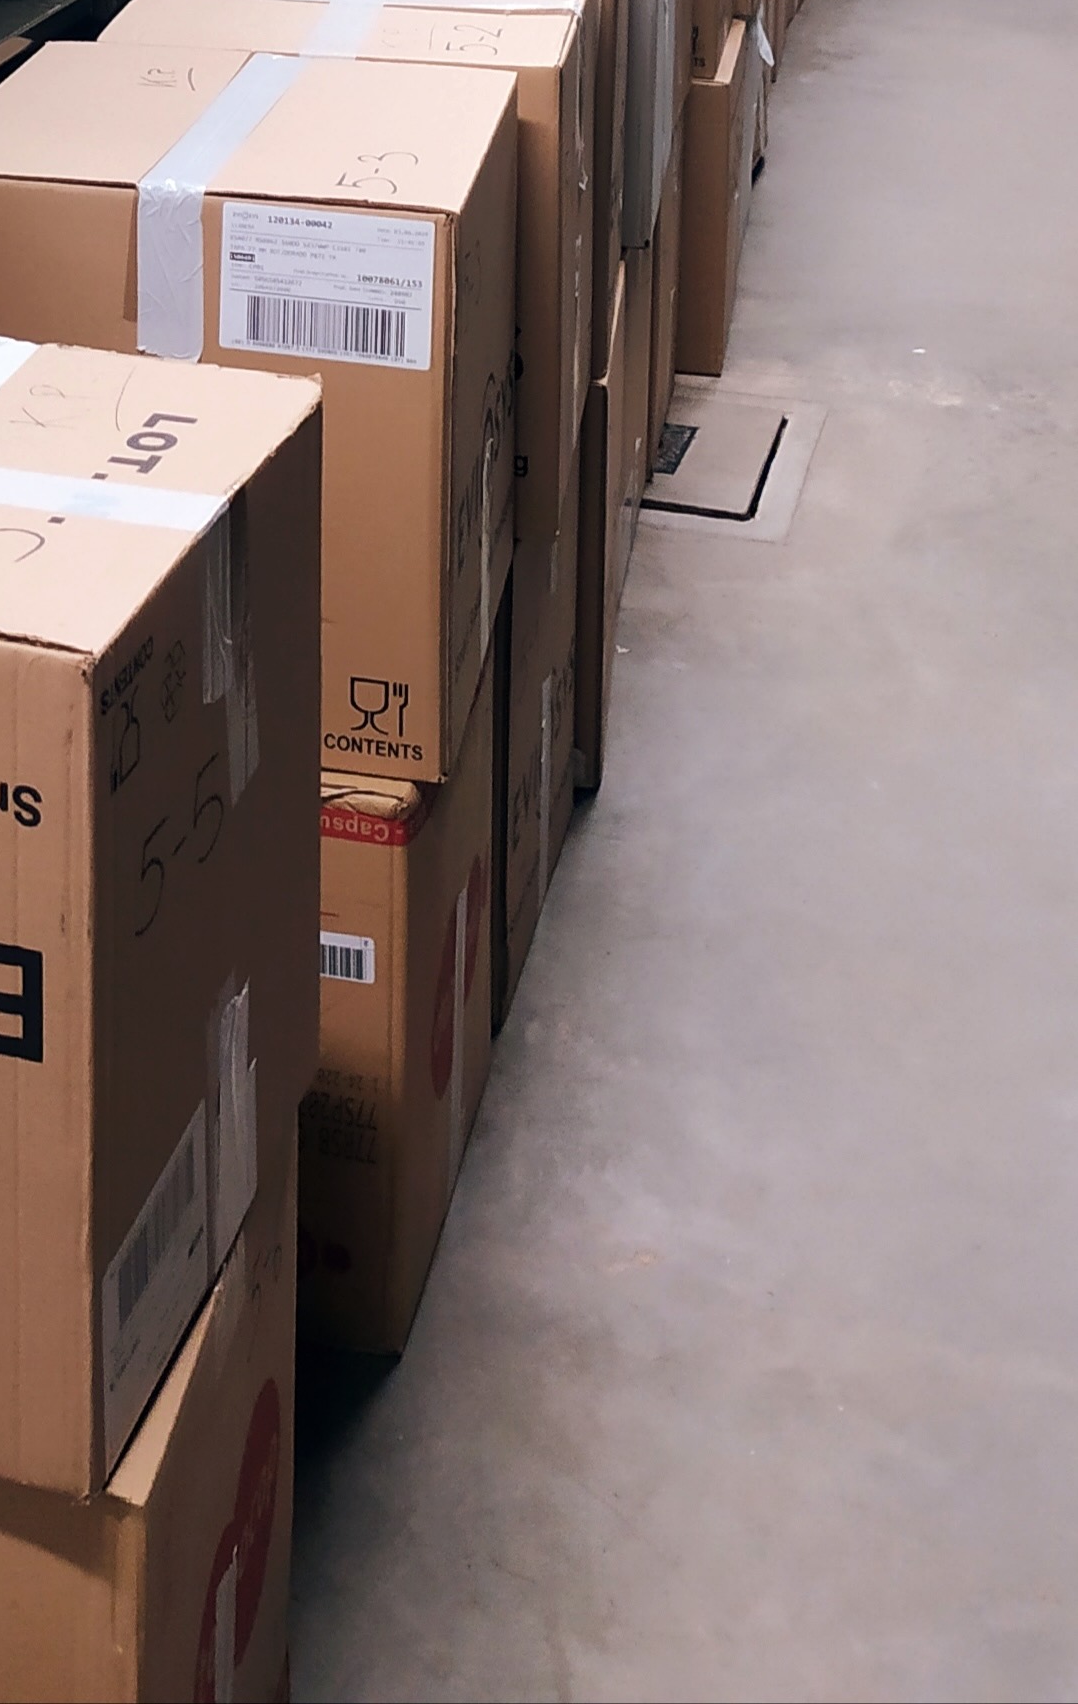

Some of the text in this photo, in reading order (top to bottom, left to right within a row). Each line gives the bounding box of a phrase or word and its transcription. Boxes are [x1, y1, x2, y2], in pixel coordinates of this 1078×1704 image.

[445, 24, 503, 56] 5-2
[335, 151, 419, 195] 5-3
[324, 733, 423, 762] CONTENTS
[320, 814, 390, 843] Capsu
[135, 753, 225, 939] 5-5
